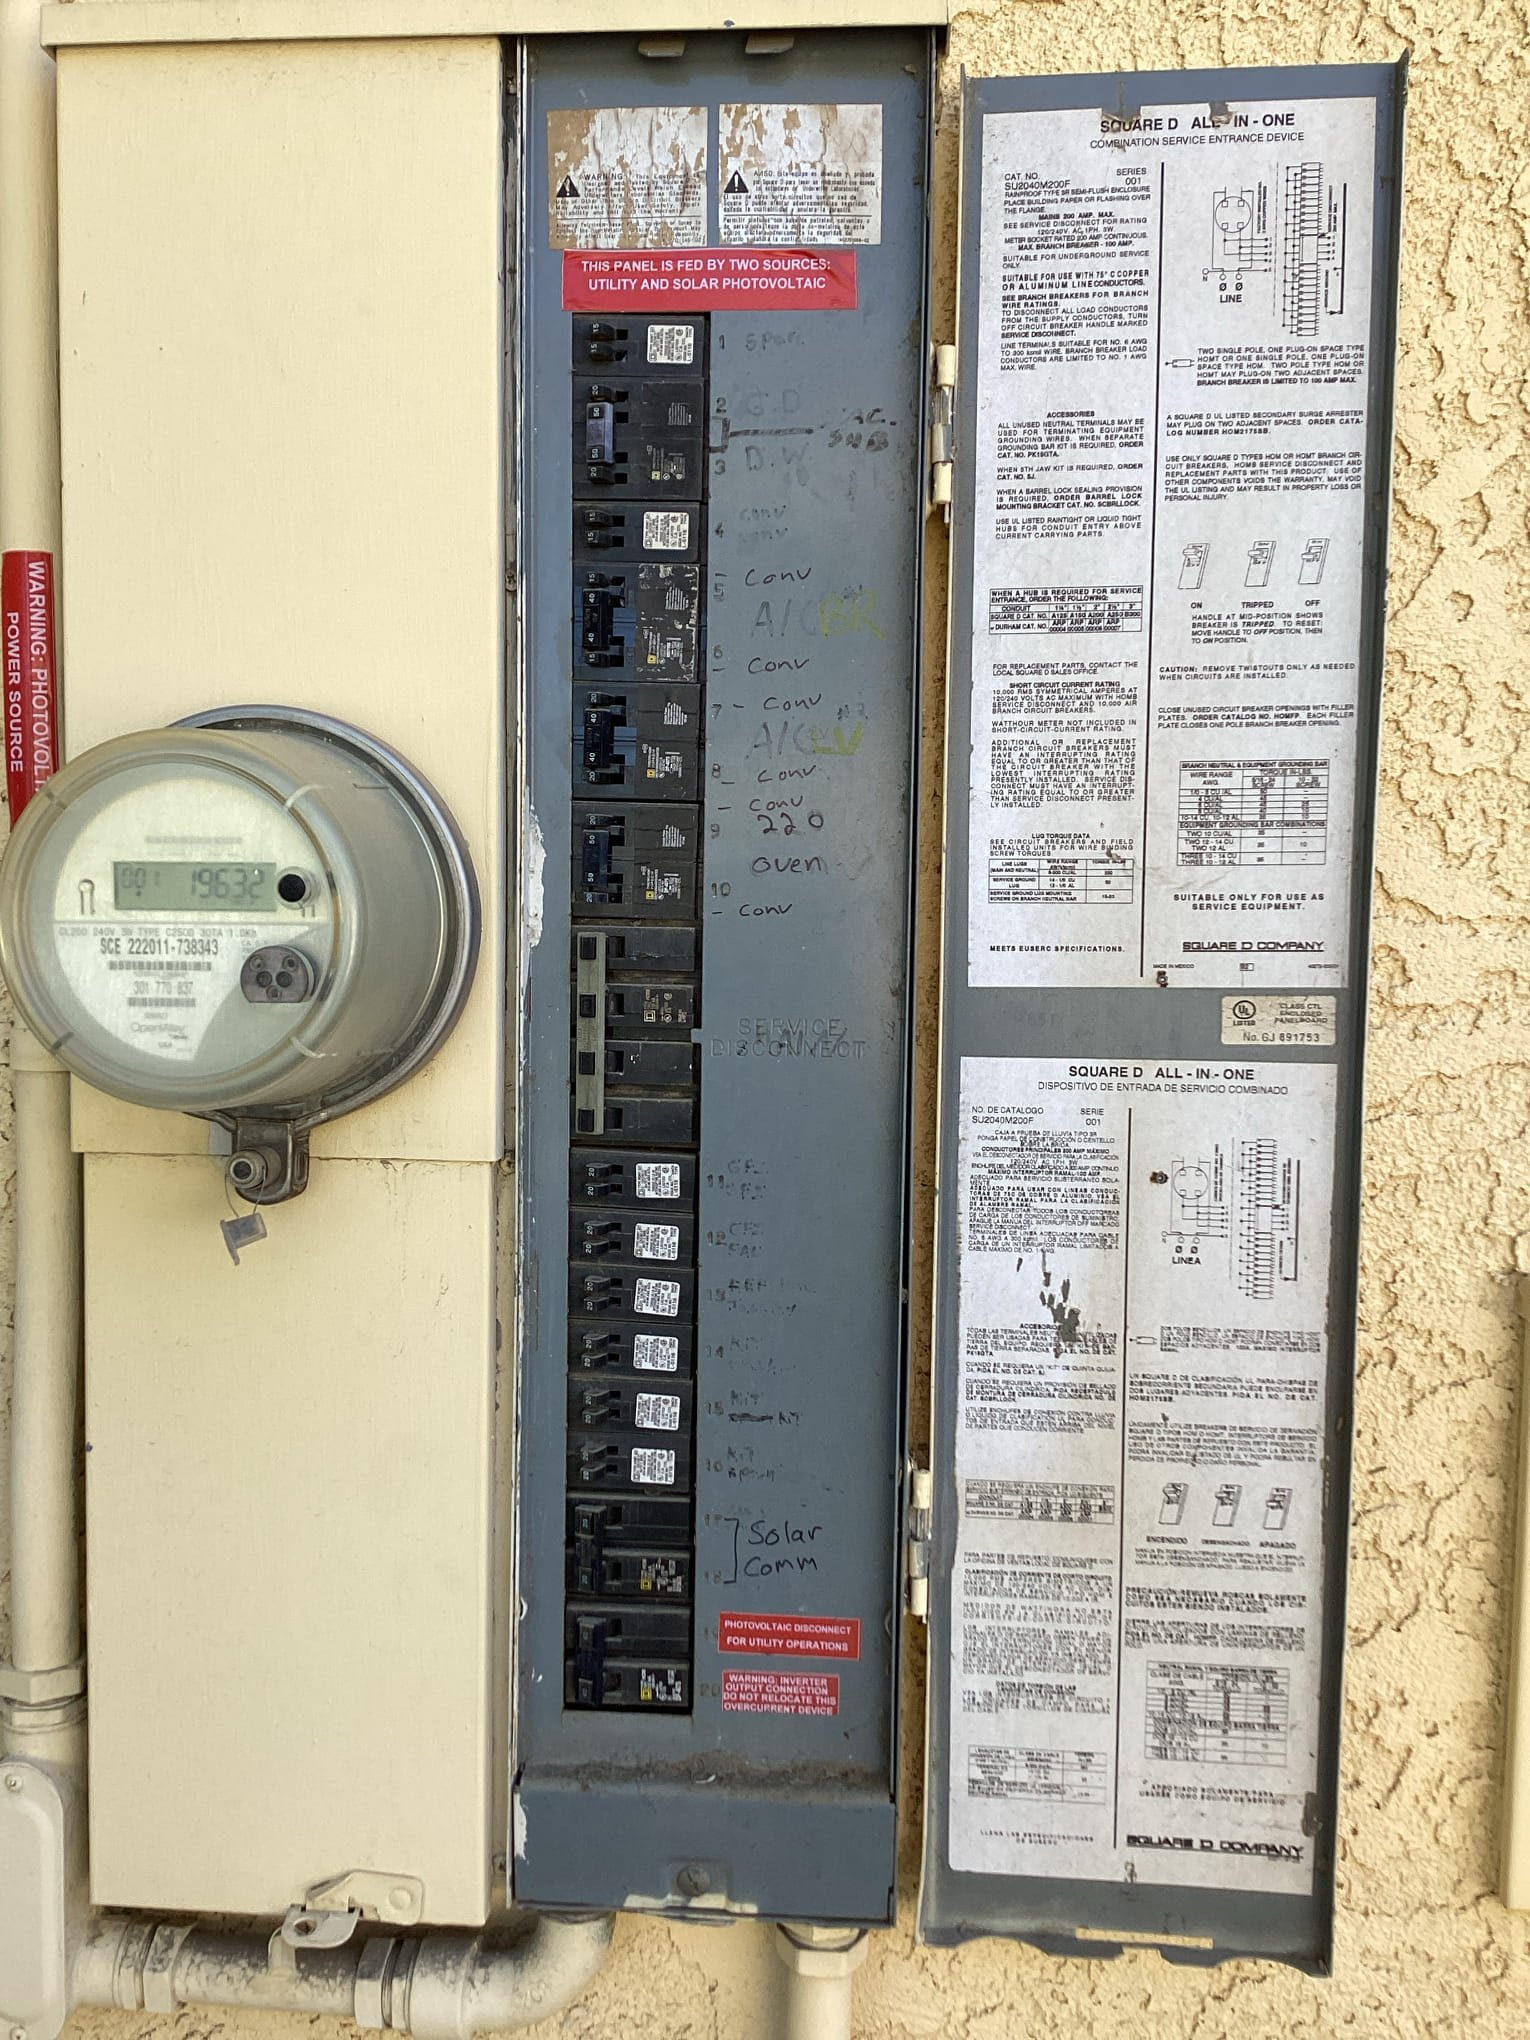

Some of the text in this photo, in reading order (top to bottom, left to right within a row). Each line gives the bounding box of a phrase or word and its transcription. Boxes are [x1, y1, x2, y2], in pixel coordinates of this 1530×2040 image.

[1100, 118, 1162, 132] SQUARE
[1167, 118, 1178, 130] D
[1234, 115, 1248, 127] IN
[1262, 114, 1295, 126] ONE
[1090, 132, 1304, 148] COMBINATION SERVICE ENTRANCE DEVICE
[1004, 172, 1040, 181] CAT. NO.
[1116, 167, 1146, 176] SERIES
[1004, 180, 1070, 190] SU2040M200F
[1125, 178, 1141, 186] 001
[581, 258, 830, 271] THIS PANEL IS FED BY TWO SOURCES:
[589, 276, 825, 290] UTILITY AND SOLAR PHOTOVOLTAIC
[1219, 294, 1242, 303] LINE
[745, 568, 812, 586] Conv
[28, 560, 46, 662] WARNING:
[748, 657, 810, 674] Conv
[7, 612, 22, 772] POWER SOURCE
[763, 694, 822, 711] Conv
[757, 765, 818, 783] Conv
[749, 796, 804, 812] Conv
[757, 811, 825, 836] 220
[1173, 893, 1224, 901] SUITABLE
[1229, 893, 1256, 901] ONLY
[739, 904, 793, 917] Conv
[1241, 902, 1304, 910] EQUIPMENT.
[100, 937, 218, 955] SCE 222011-738343
[1182, 941, 1324, 949] SQUARE D COMPANY
[739, 1018, 844, 1037] SERVICE
[1242, 1032, 1319, 1042] No. GJ 891753
[712, 1040, 865, 1058] DISCONNECT
[1069, 1065, 1254, 1080] SQUARE D ALL IN ONE
[1038, 1081, 1288, 1094] DISPOSITIVO DE ENTRADA DE SERVICIO COMBINADO
[971, 1105, 983, 1113] NO.
[1000, 1106, 1043, 1114] CATALOGO
[1080, 1107, 1104, 1115] SERIE
[971, 1115, 1033, 1124] SU2040M200F
[1085, 1118, 1100, 1126] 001
[1172, 1256, 1200, 1264] LINEA
[748, 1520, 823, 1546] Solar
[724, 1620, 850, 1634] PHOTOVOLTAIC DISCONNECT
[726, 1636, 848, 1651] FOR UTILITY OPERATIONS
[728, 1674, 827, 1686] WARNING: INVERTER
[725, 1682, 828, 1695] OUTPUT CONNECTION
[723, 1692, 836, 1705] DO NOT RELOCATE THIS
[724, 1702, 832, 1715] OVERCURRENT DEVICE
[1127, 1834, 1304, 1857] SQUARE D COMPANY
